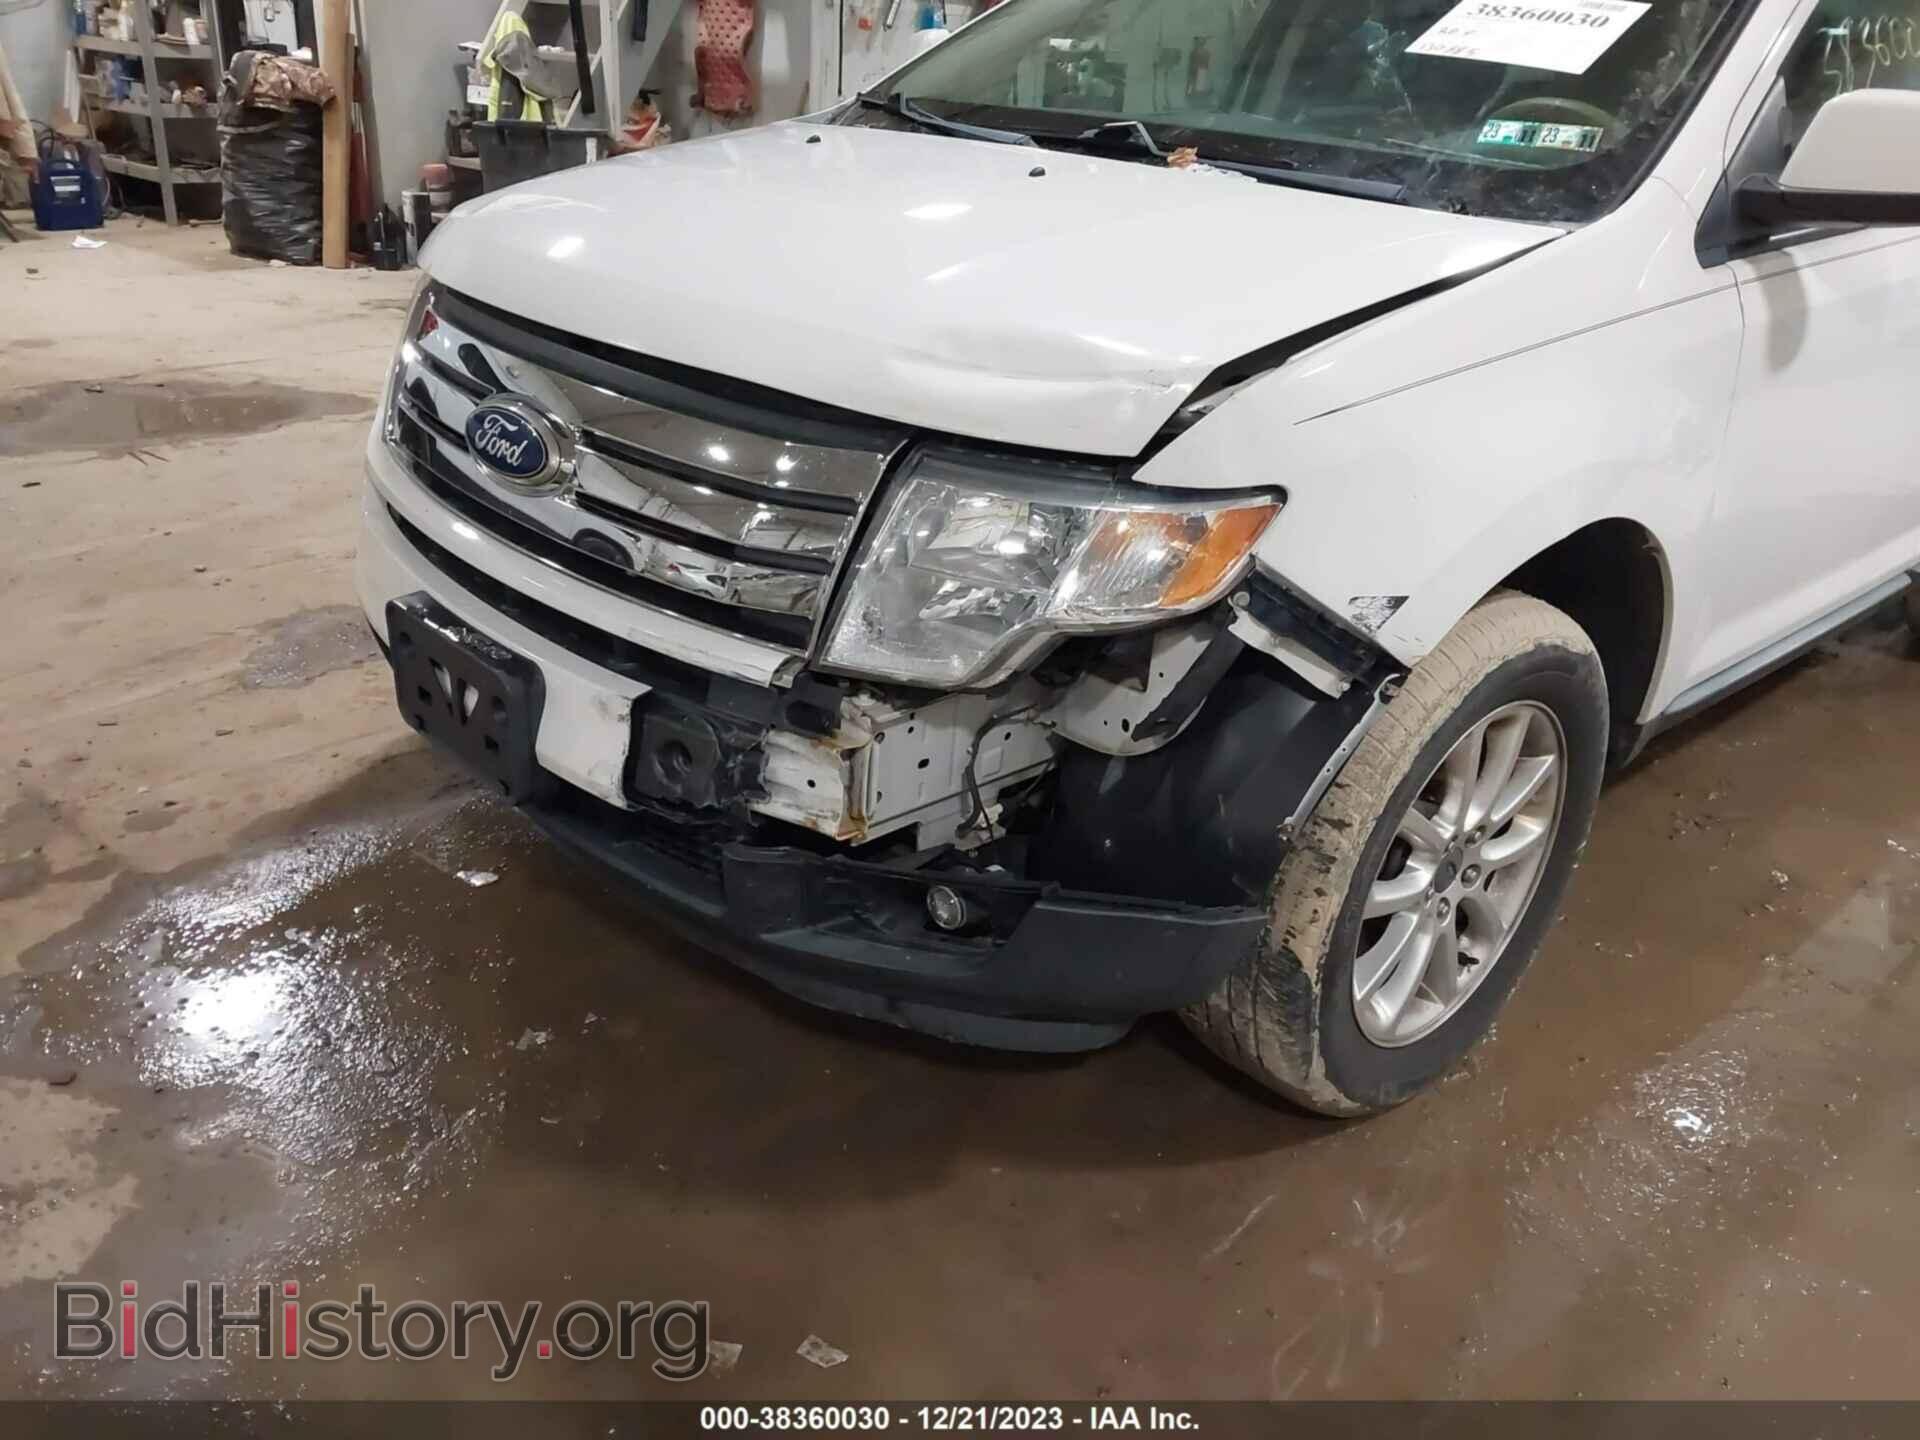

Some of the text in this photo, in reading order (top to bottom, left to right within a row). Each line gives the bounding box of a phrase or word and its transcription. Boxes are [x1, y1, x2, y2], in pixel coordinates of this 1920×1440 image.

[1467, 3, 1610, 27] 38360030
[1541, 127, 1560, 143] 23
[475, 414, 529, 467] Ford
